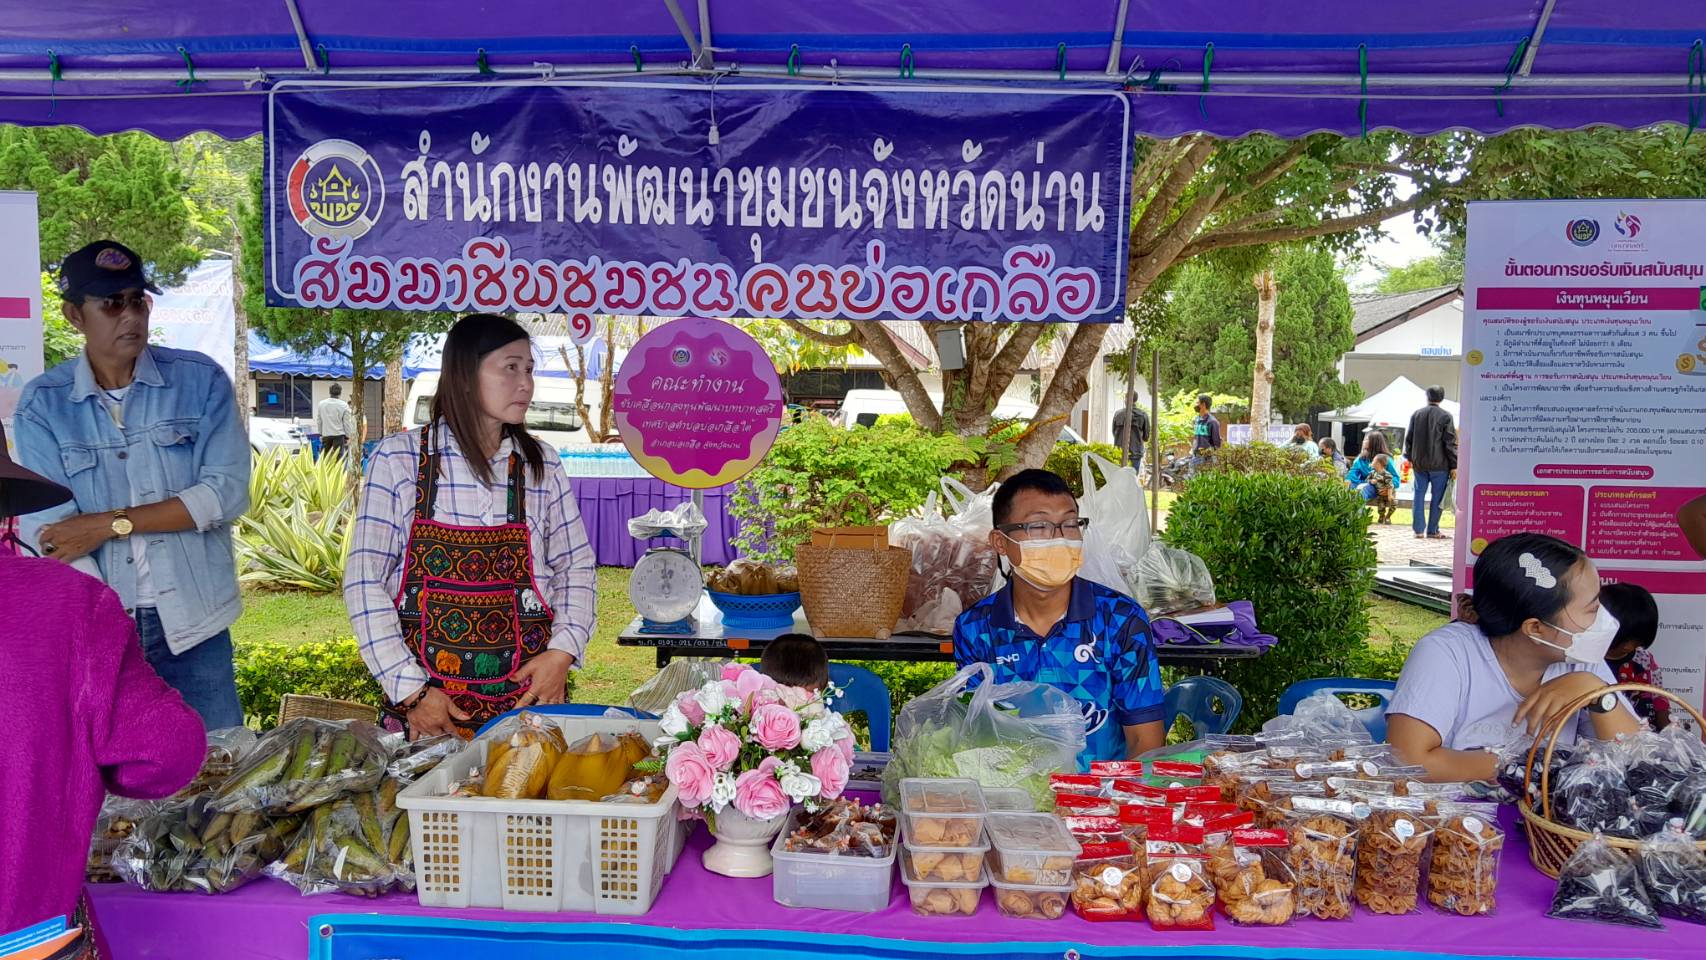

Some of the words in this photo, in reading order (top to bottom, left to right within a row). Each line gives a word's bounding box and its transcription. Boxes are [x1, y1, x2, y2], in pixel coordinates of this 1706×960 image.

[401, 130, 1105, 264] สำนักงานพัฒนาชุมชนจังหวัดน่าน
[1504, 257, 1704, 280] ขั้นตอนการขอรับเงินสนับสนุน
[1556, 291, 1648, 309] เงินทุนหมุนเวียน
[651, 374, 745, 393] คณะทำงาน
